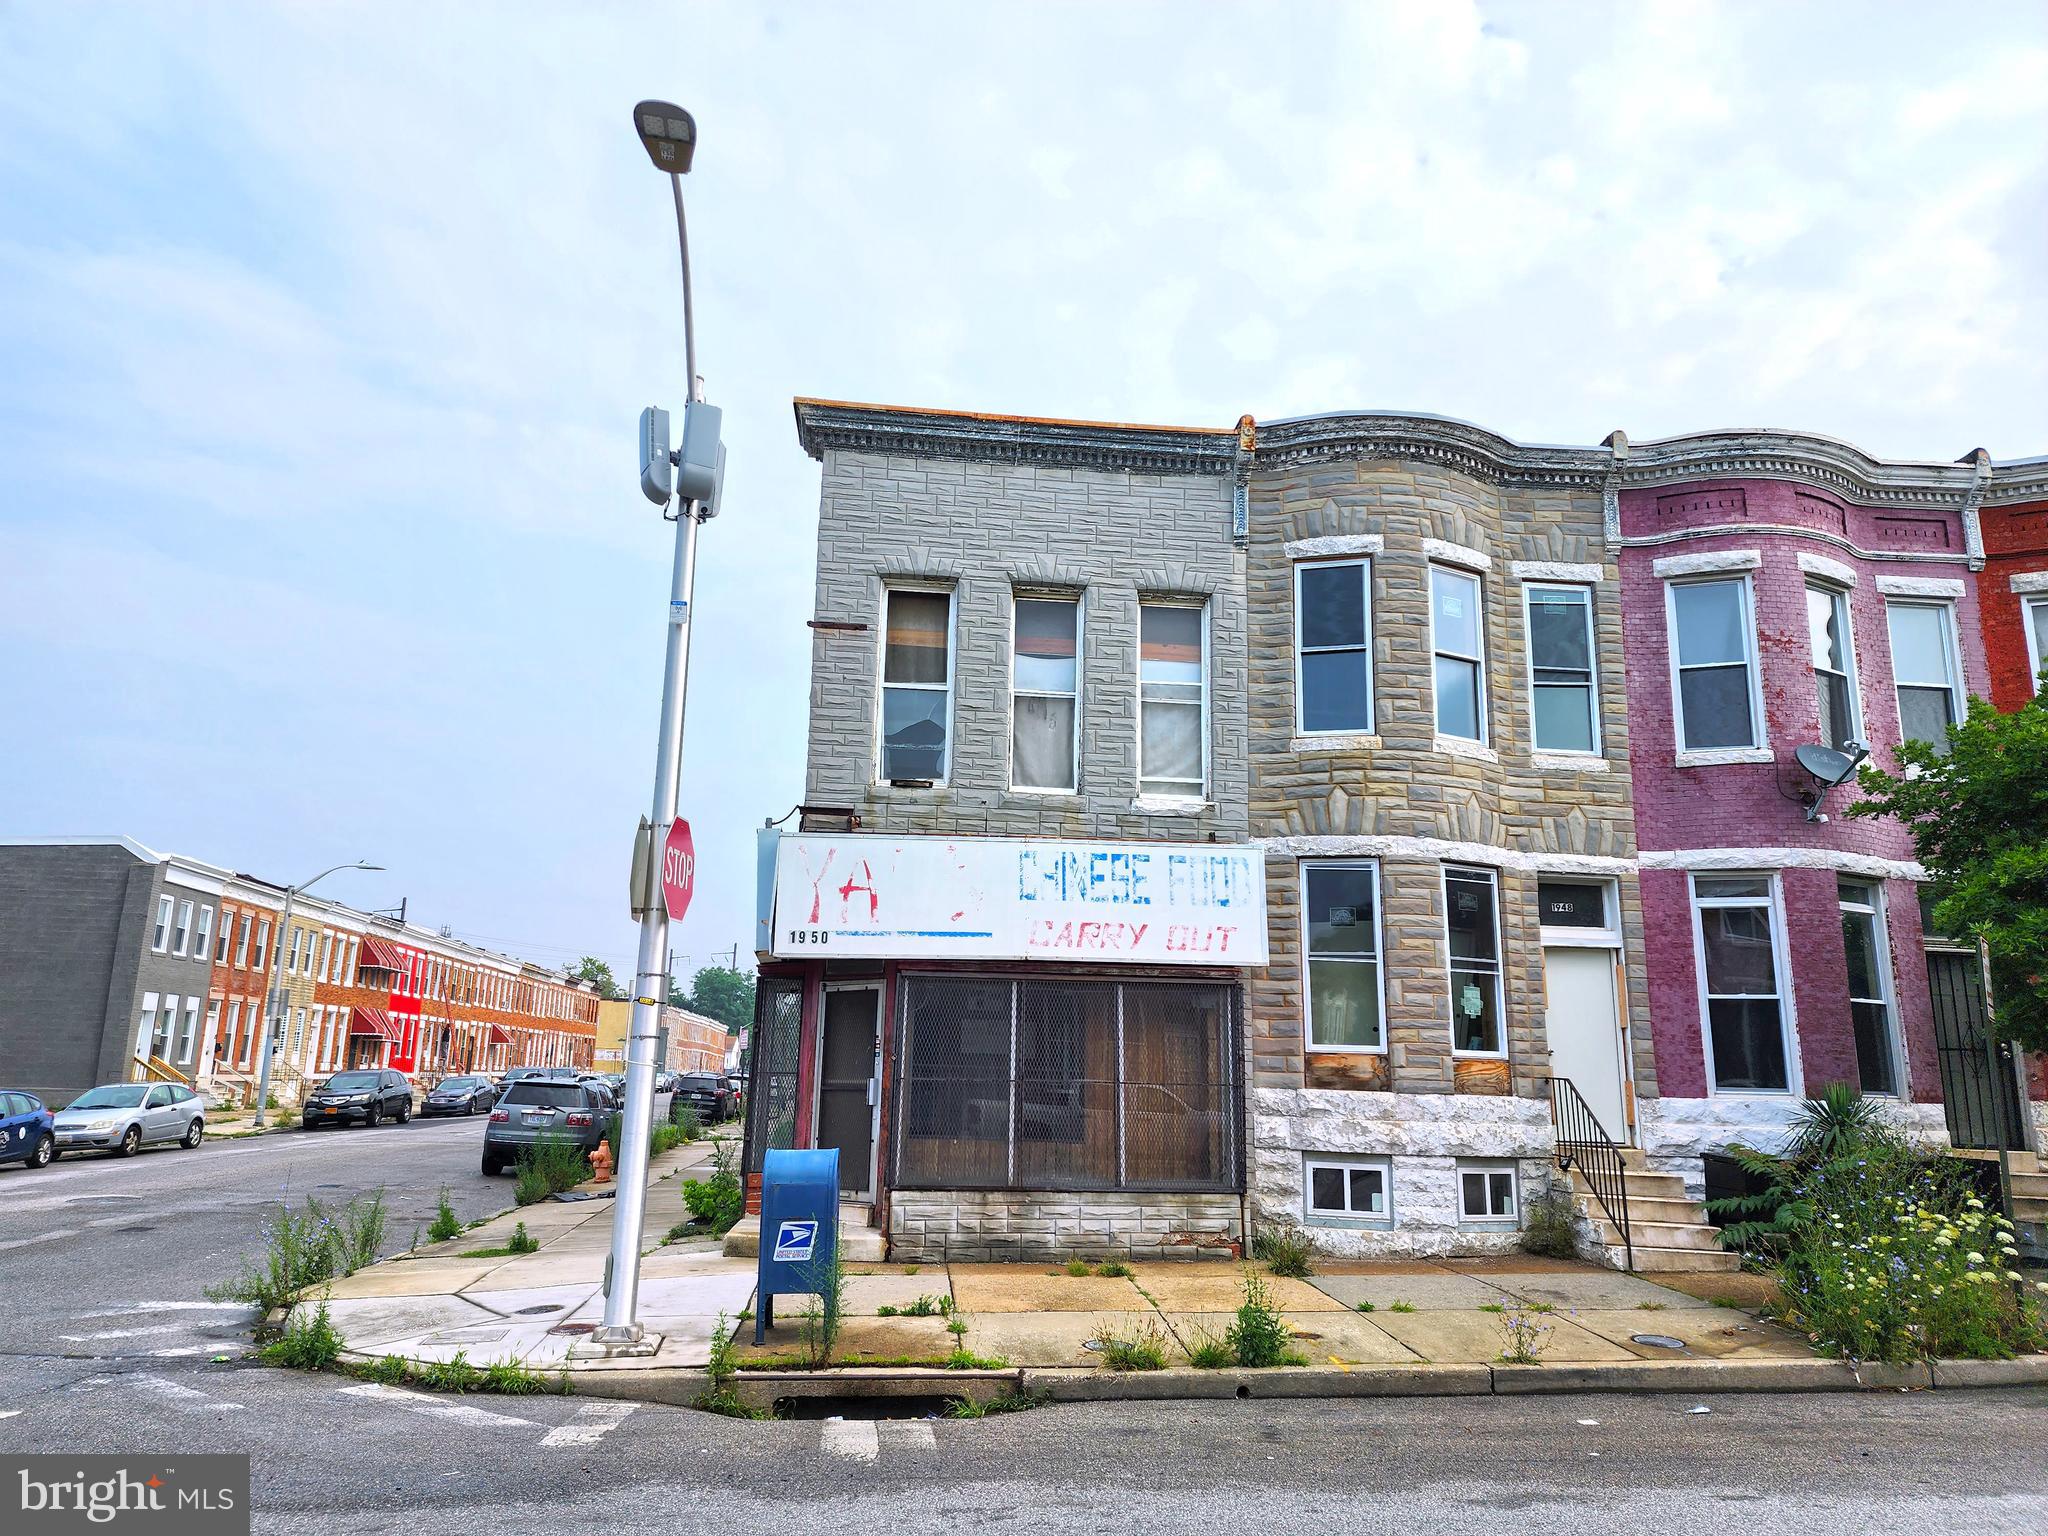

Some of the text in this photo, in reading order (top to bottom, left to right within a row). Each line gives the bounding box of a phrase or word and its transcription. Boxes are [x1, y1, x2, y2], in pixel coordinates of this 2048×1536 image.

[665, 846, 693, 890] STOP
[1551, 902, 1574, 912] 1948
[790, 930, 829, 944] 1950
[1028, 920, 1238, 952] CARRY OUT
